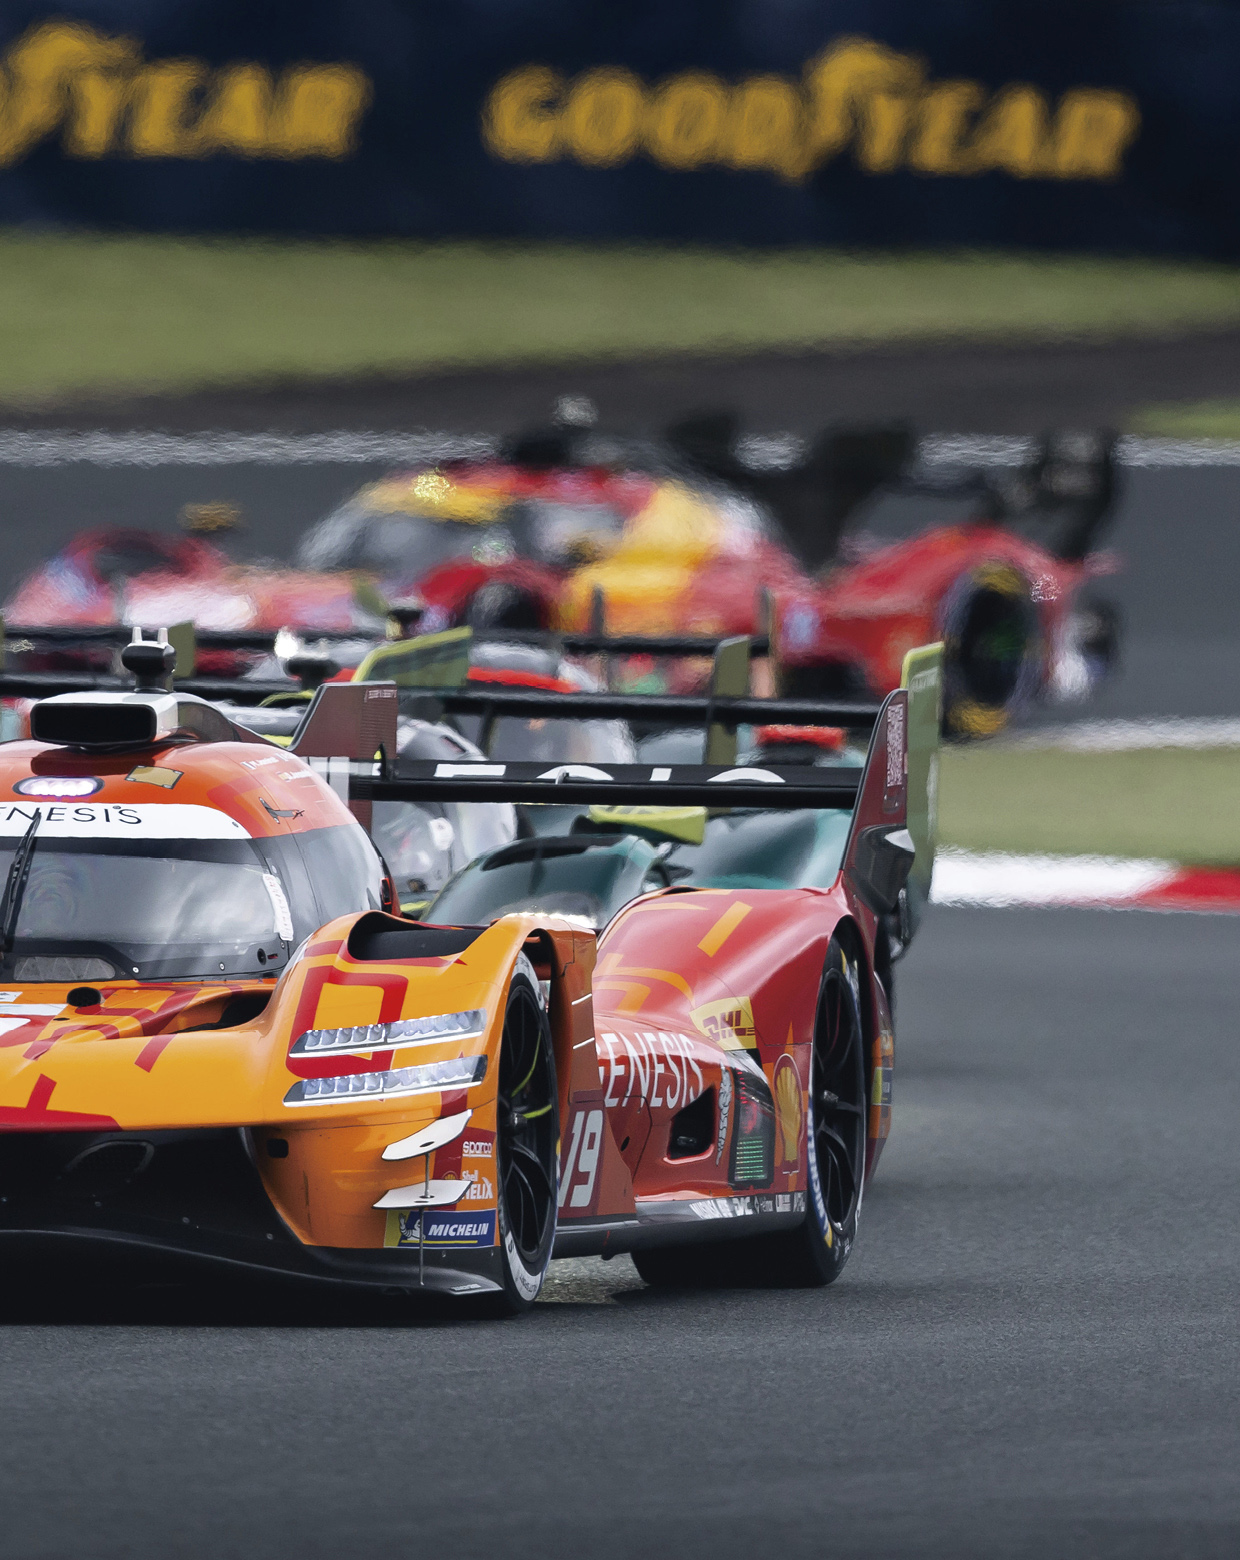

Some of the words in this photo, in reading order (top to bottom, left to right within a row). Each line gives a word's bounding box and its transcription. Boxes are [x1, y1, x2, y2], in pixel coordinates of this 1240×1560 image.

[483, 36, 1140, 183] GOODYEAR
[703, 1009, 747, 1042] DHL
[462, 1140, 492, 1154] sparco
[557, 1109, 604, 1208] 19
[462, 1169, 479, 1181] Shell
[428, 1222, 490, 1237] MICHELIN
